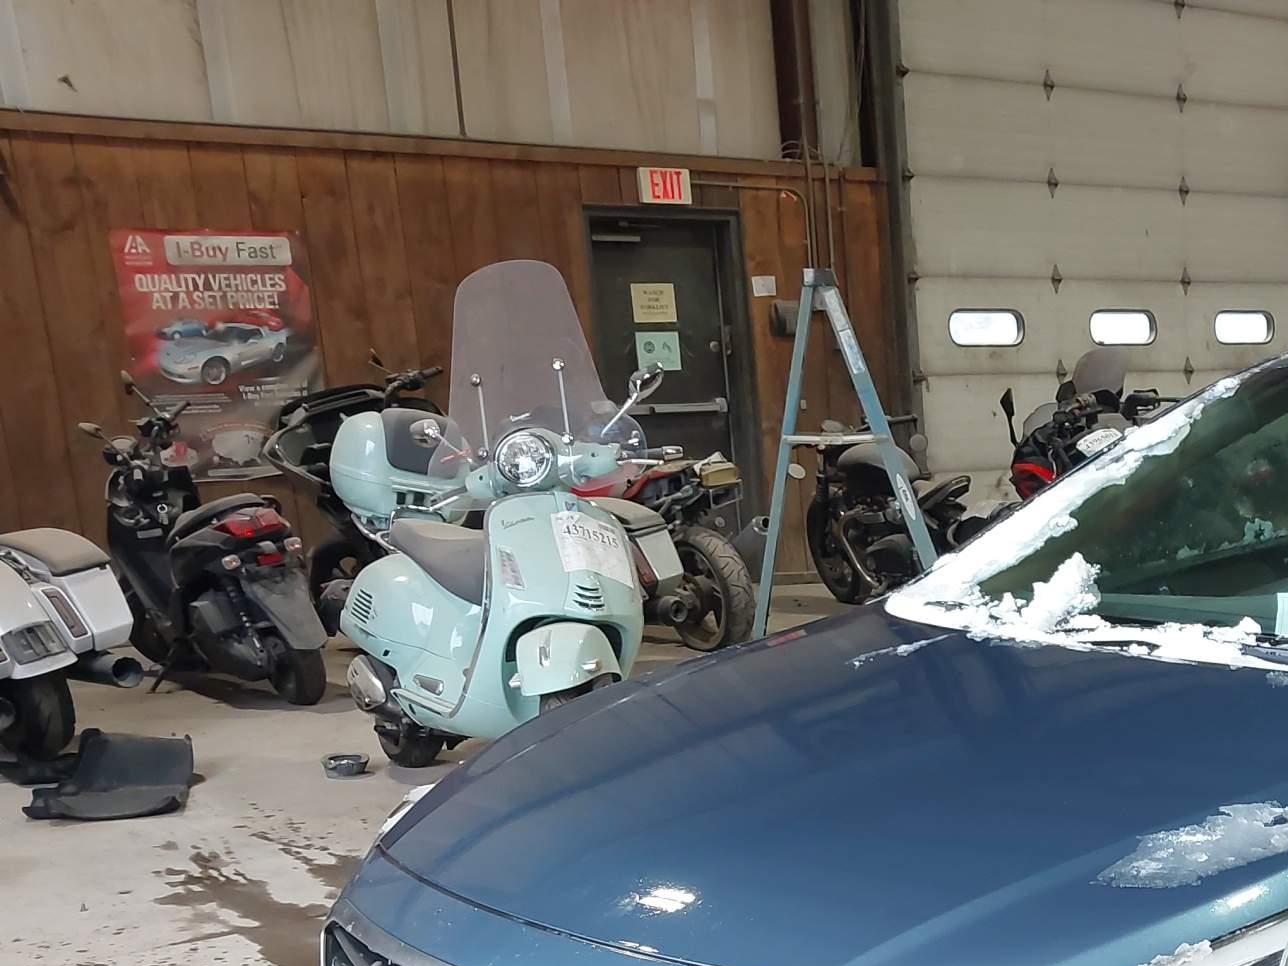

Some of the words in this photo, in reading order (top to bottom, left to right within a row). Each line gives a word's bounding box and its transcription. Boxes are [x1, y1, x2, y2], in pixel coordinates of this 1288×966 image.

[649, 170, 683, 200] EXIT
[175, 241, 229, 262] I-Buy
[235, 241, 276, 259] Fast
[134, 273, 205, 292] QUALITY
[207, 274, 287, 292] VEHICLES
[152, 292, 175, 310] AT
[177, 292, 192, 310] A
[194, 293, 223, 310] SET
[228, 292, 280, 309] PRICE!
[564, 524, 619, 549] 43715215
